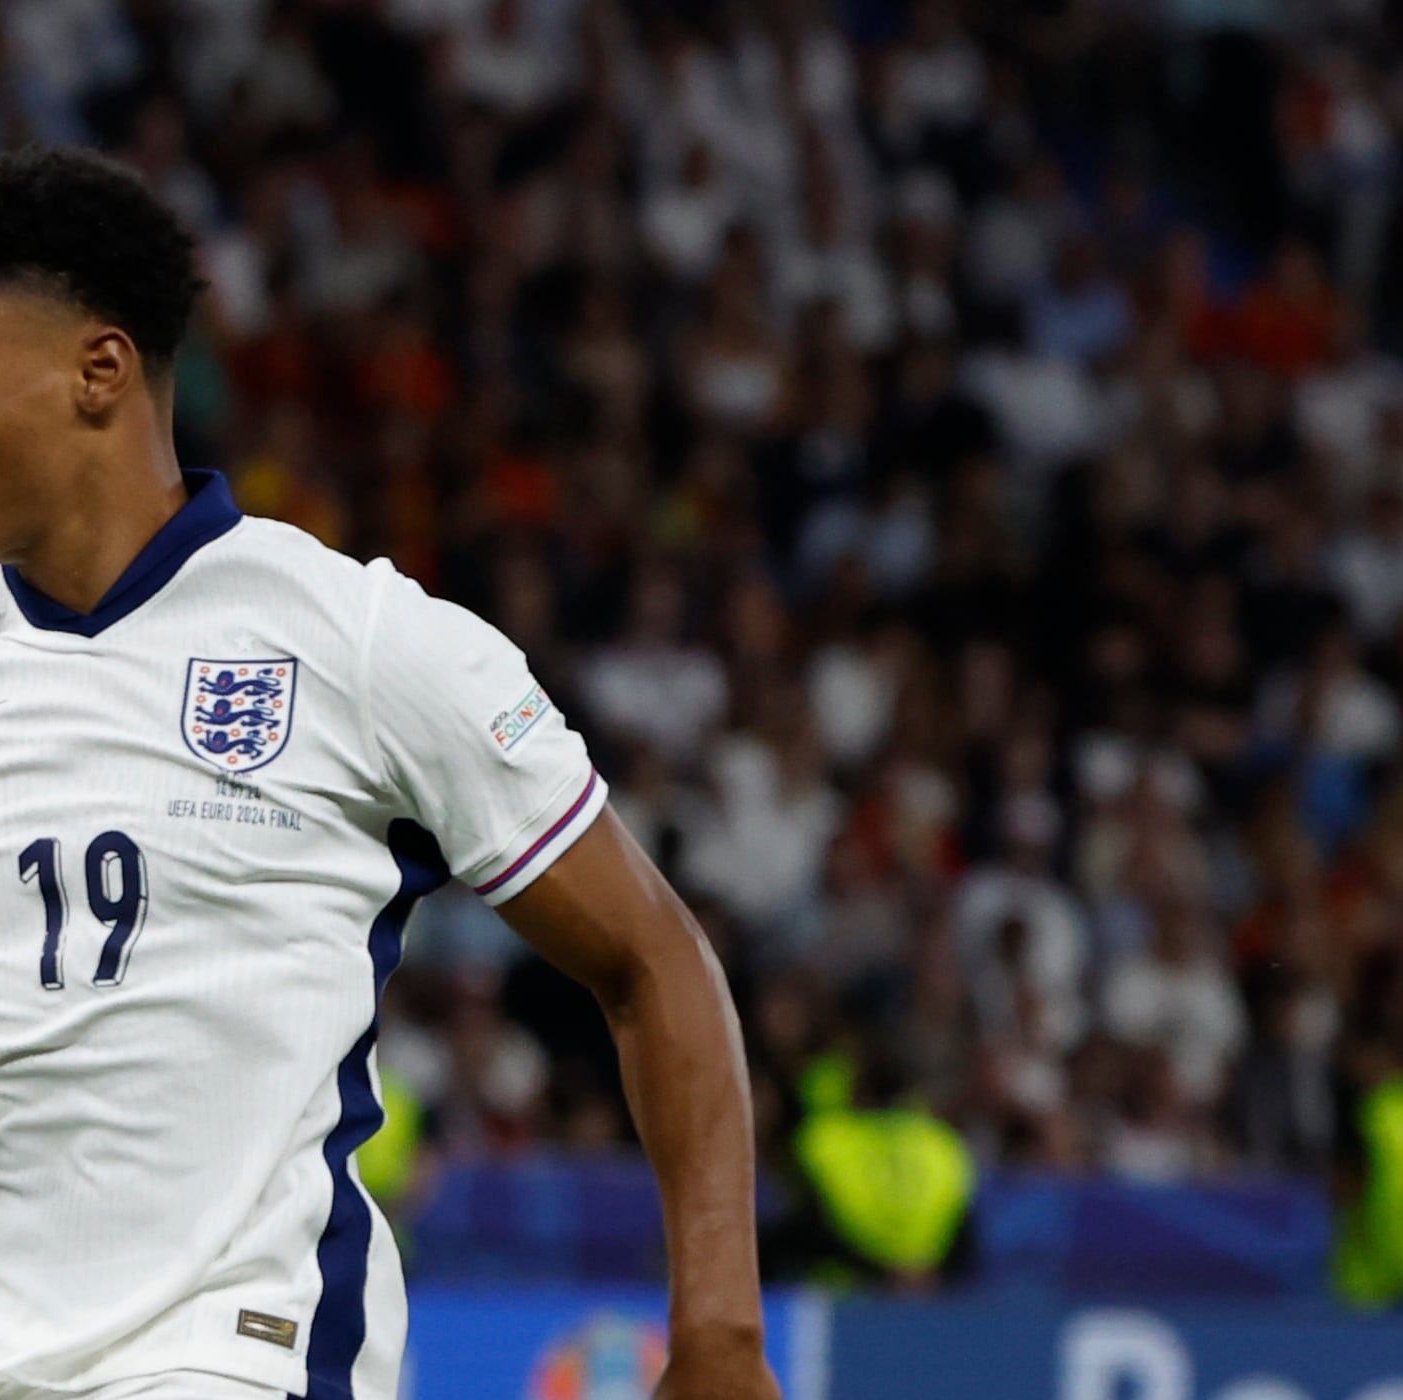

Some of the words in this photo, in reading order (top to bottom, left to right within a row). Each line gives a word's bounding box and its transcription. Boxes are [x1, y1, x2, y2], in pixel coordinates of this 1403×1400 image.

[167, 800, 196, 818] UEFA
[201, 802, 234, 821] EURO
[236, 805, 266, 826] 2024
[269, 809, 302, 831] FINAL
[18, 830, 148, 990] 19
